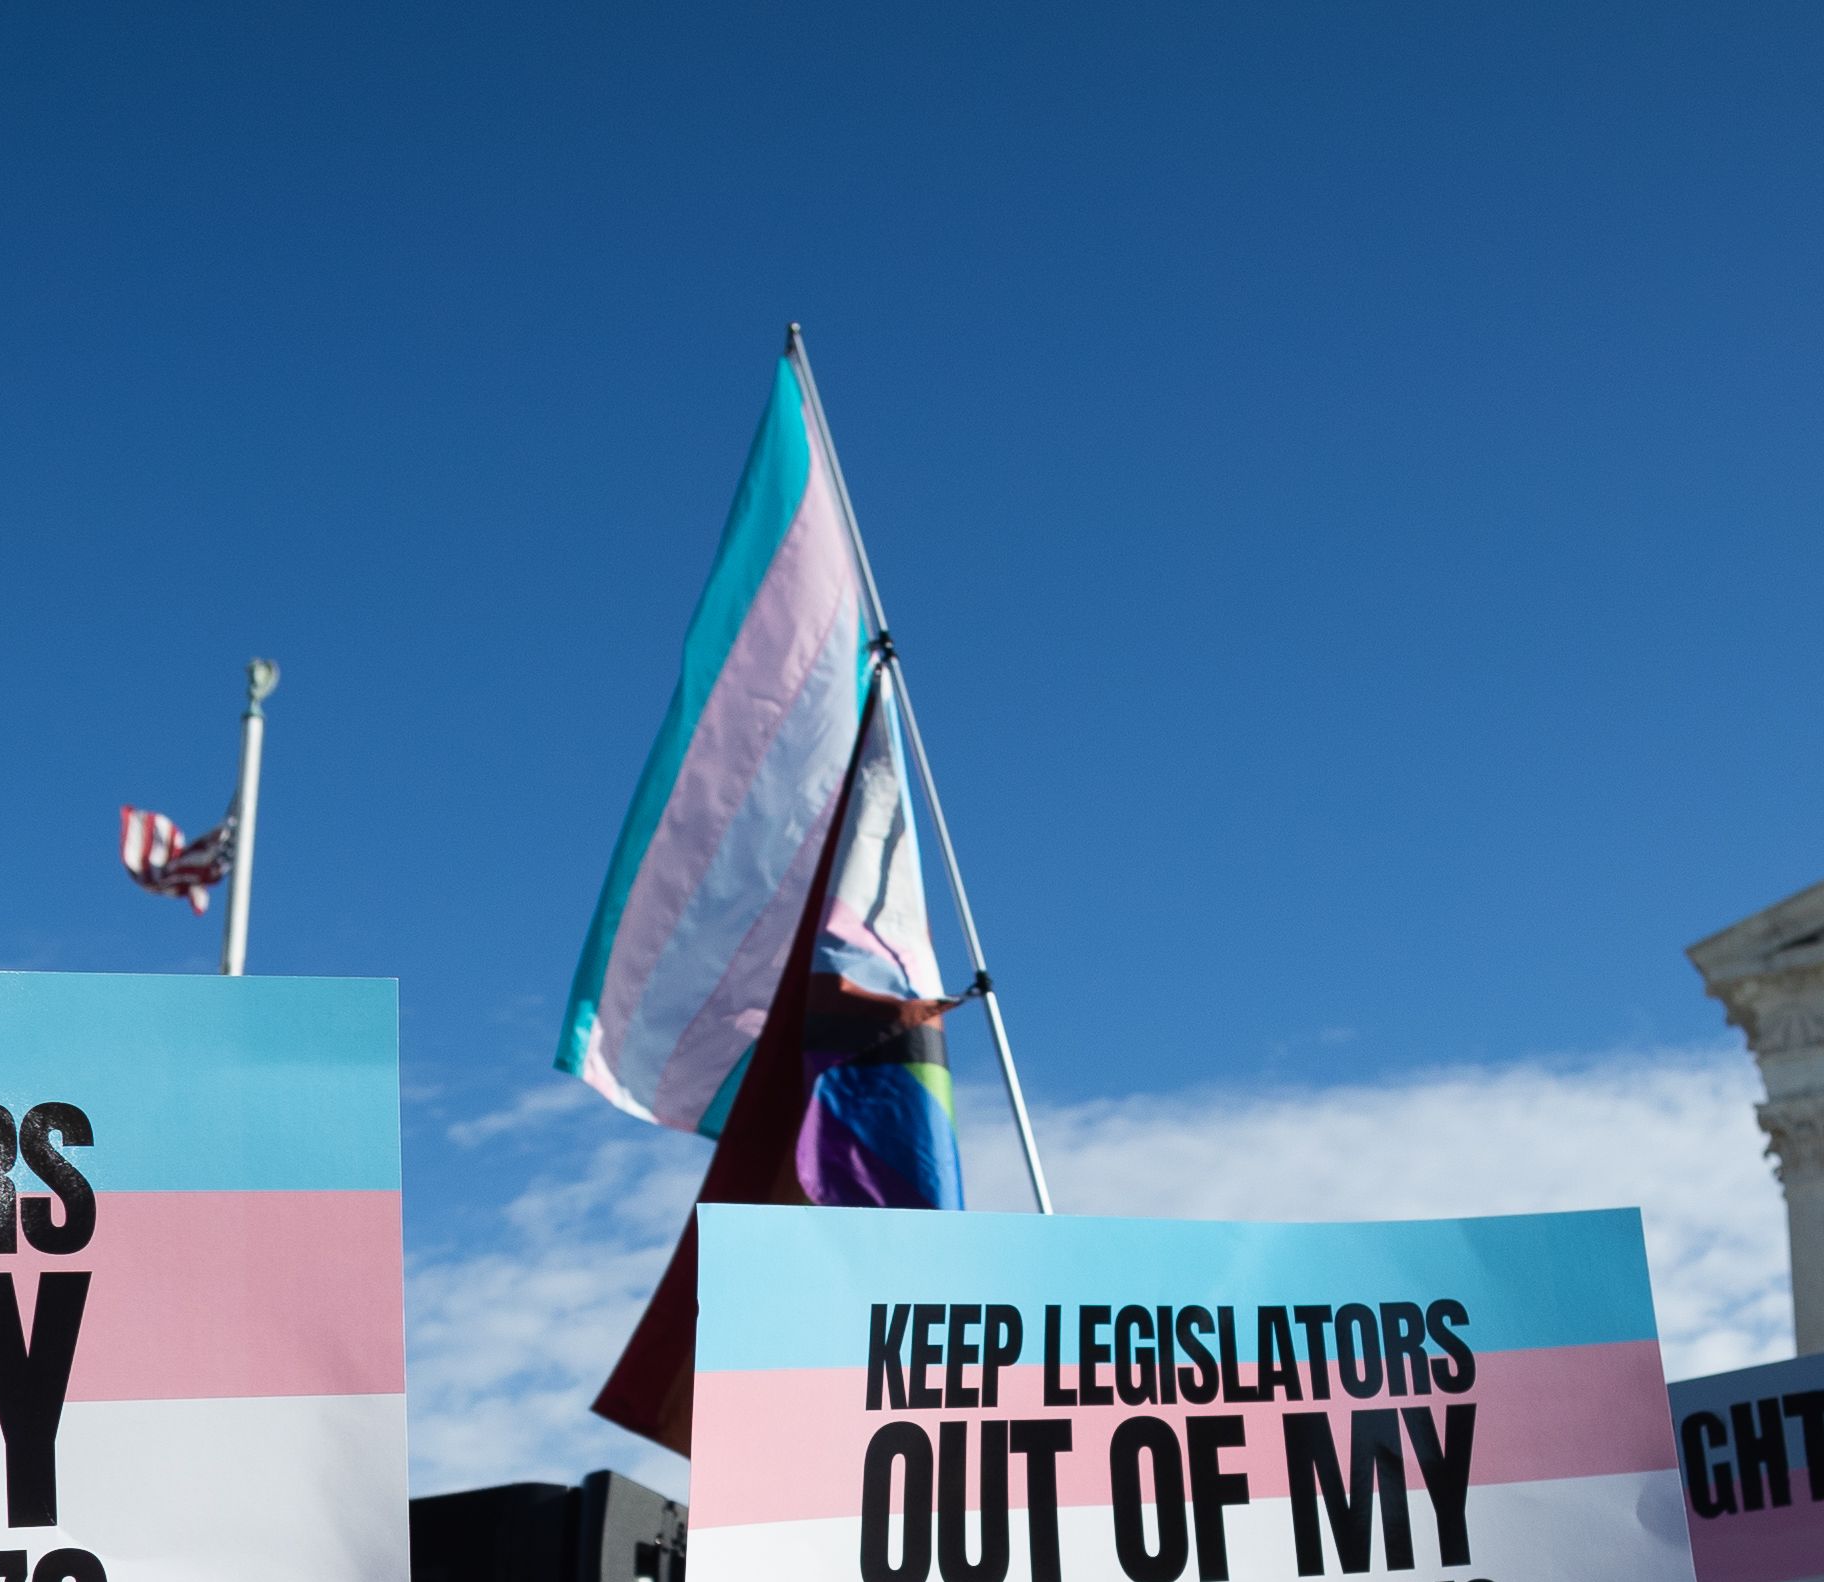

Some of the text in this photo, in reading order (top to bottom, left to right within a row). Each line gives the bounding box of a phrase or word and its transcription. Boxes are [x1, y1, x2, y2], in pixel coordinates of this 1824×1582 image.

[866, 1298, 1476, 1411] KEEP LEGISLATORS
[1282, 1402, 1477, 1578] MY
